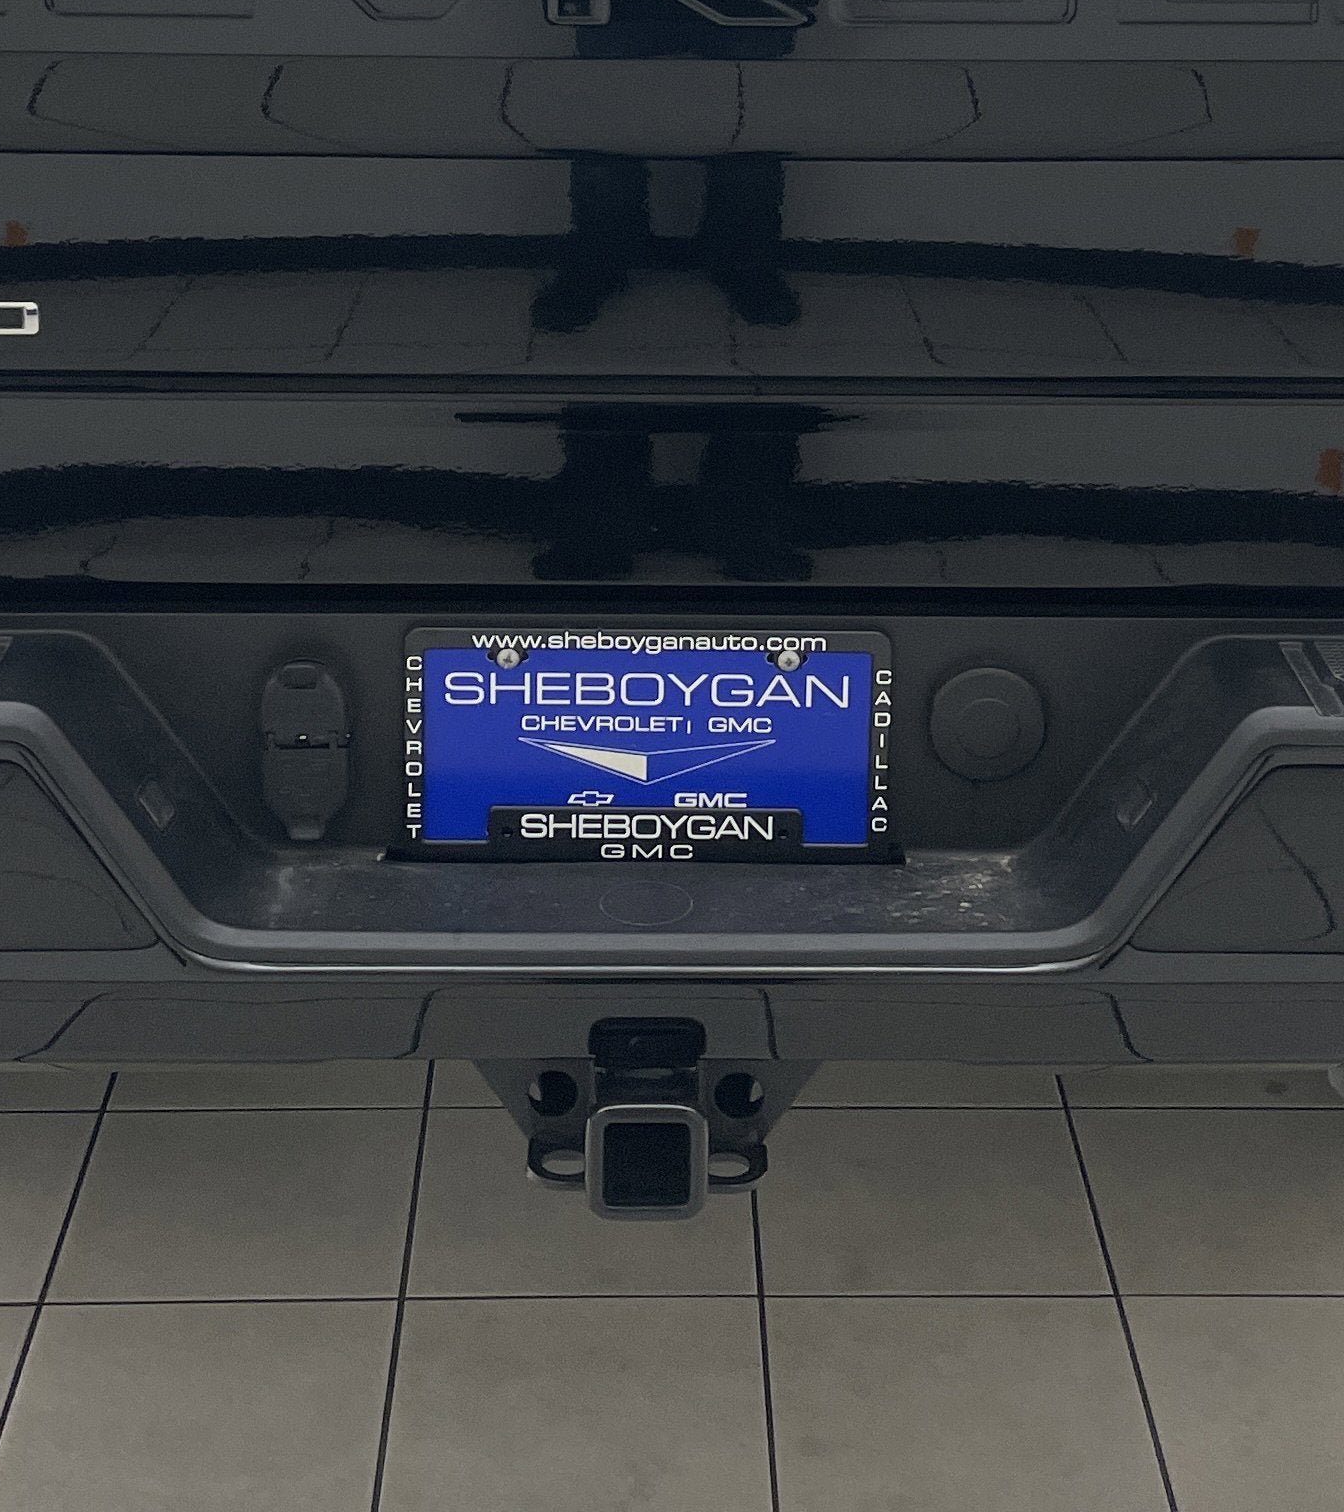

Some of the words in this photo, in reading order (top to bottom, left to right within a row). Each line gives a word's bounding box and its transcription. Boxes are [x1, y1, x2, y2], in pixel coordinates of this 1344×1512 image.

[472, 631, 827, 654] www.sheboyganauto.com
[443, 671, 850, 709] SHEBOYGAN
[521, 715, 684, 733] CHEVROLET
[707, 716, 773, 734] GMC
[405, 655, 424, 839] CHEVROLET
[870, 670, 893, 834] CADILLAC
[673, 792, 748, 808] GMC
[519, 814, 774, 841] SHEBOYGAN
[600, 844, 694, 860] GMC
